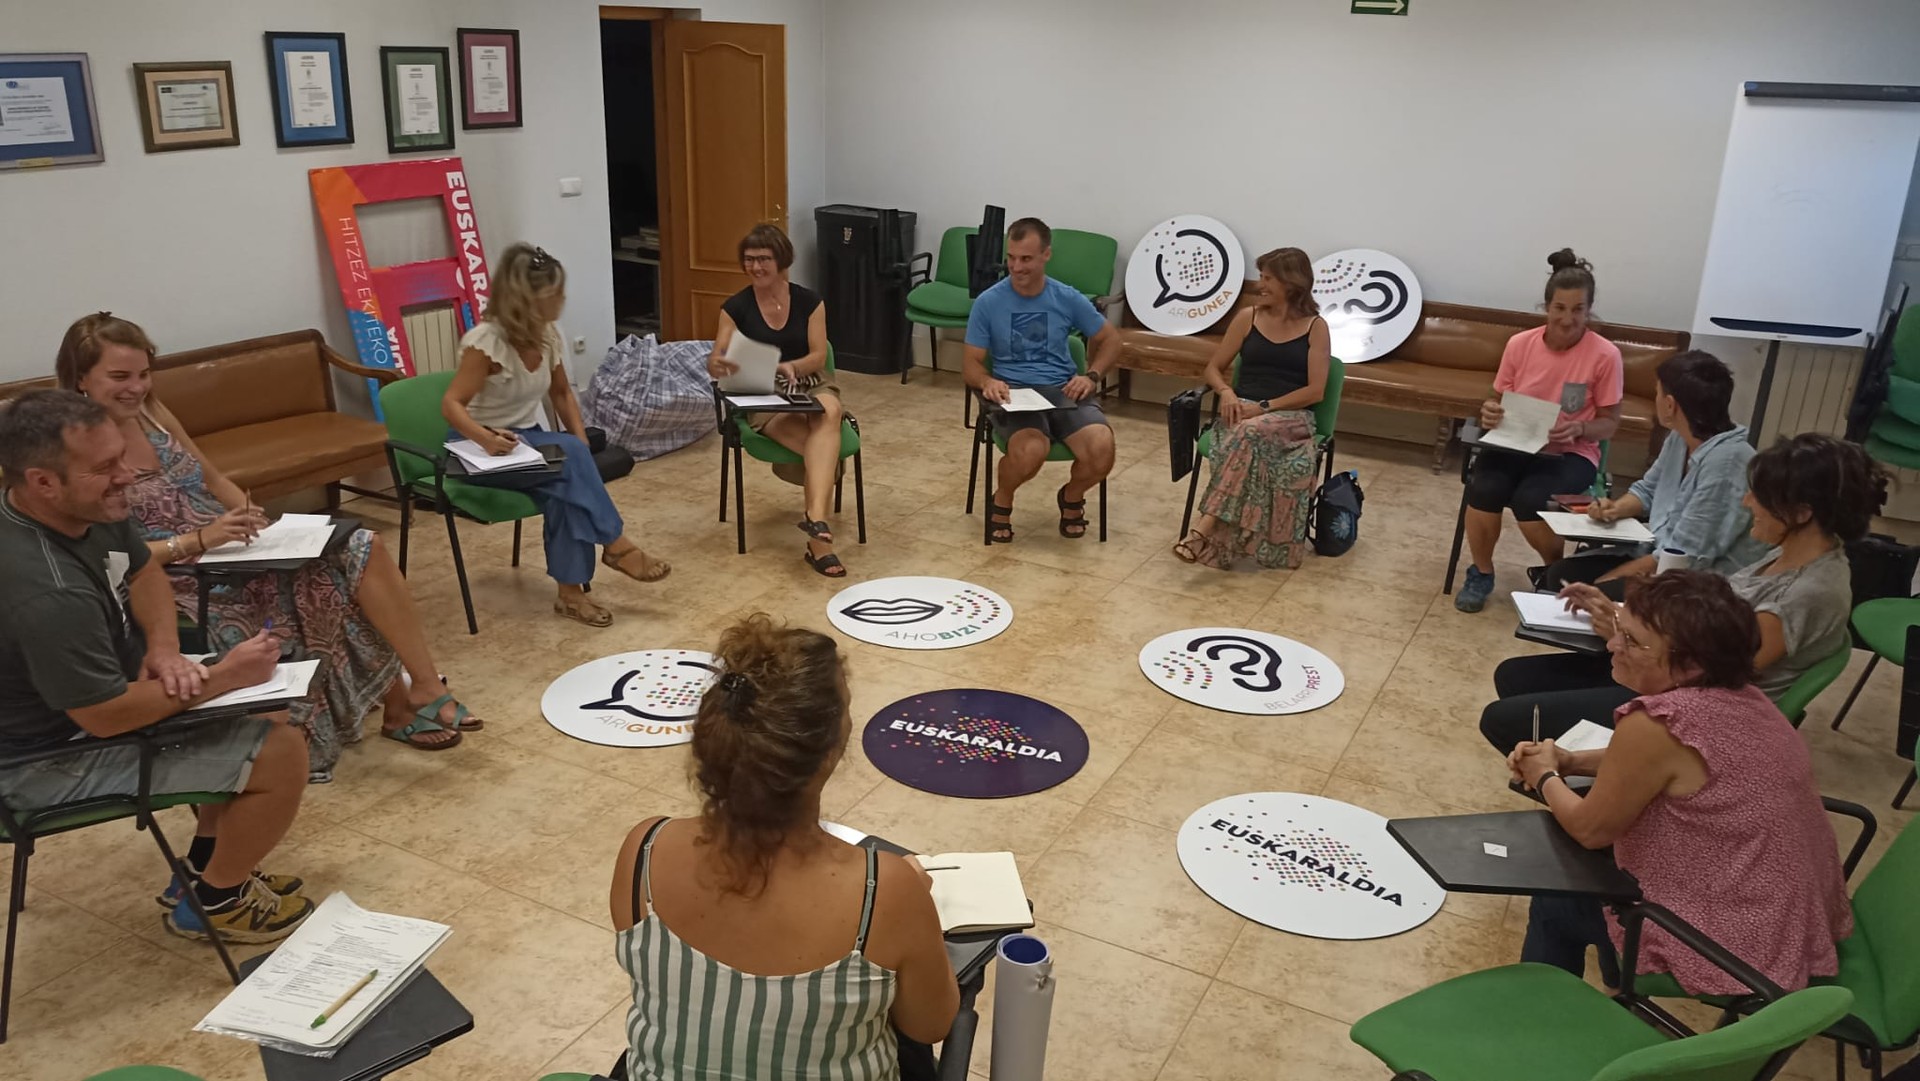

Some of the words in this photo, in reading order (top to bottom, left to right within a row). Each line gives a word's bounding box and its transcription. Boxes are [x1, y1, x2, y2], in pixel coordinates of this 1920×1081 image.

[446, 171, 490, 317] EUSKARA
[339, 217, 367, 283] HITZEZ
[357, 287, 388, 364] EKITEKO
[1168, 290, 1233, 318] ARIGUNEA
[885, 624, 982, 641] AHOBIZI
[1265, 664, 1321, 711] BELARRIPREST
[889, 720, 1062, 763] EUSKARALDIA
[1210, 819, 1403, 907] EUSKARALDIA
